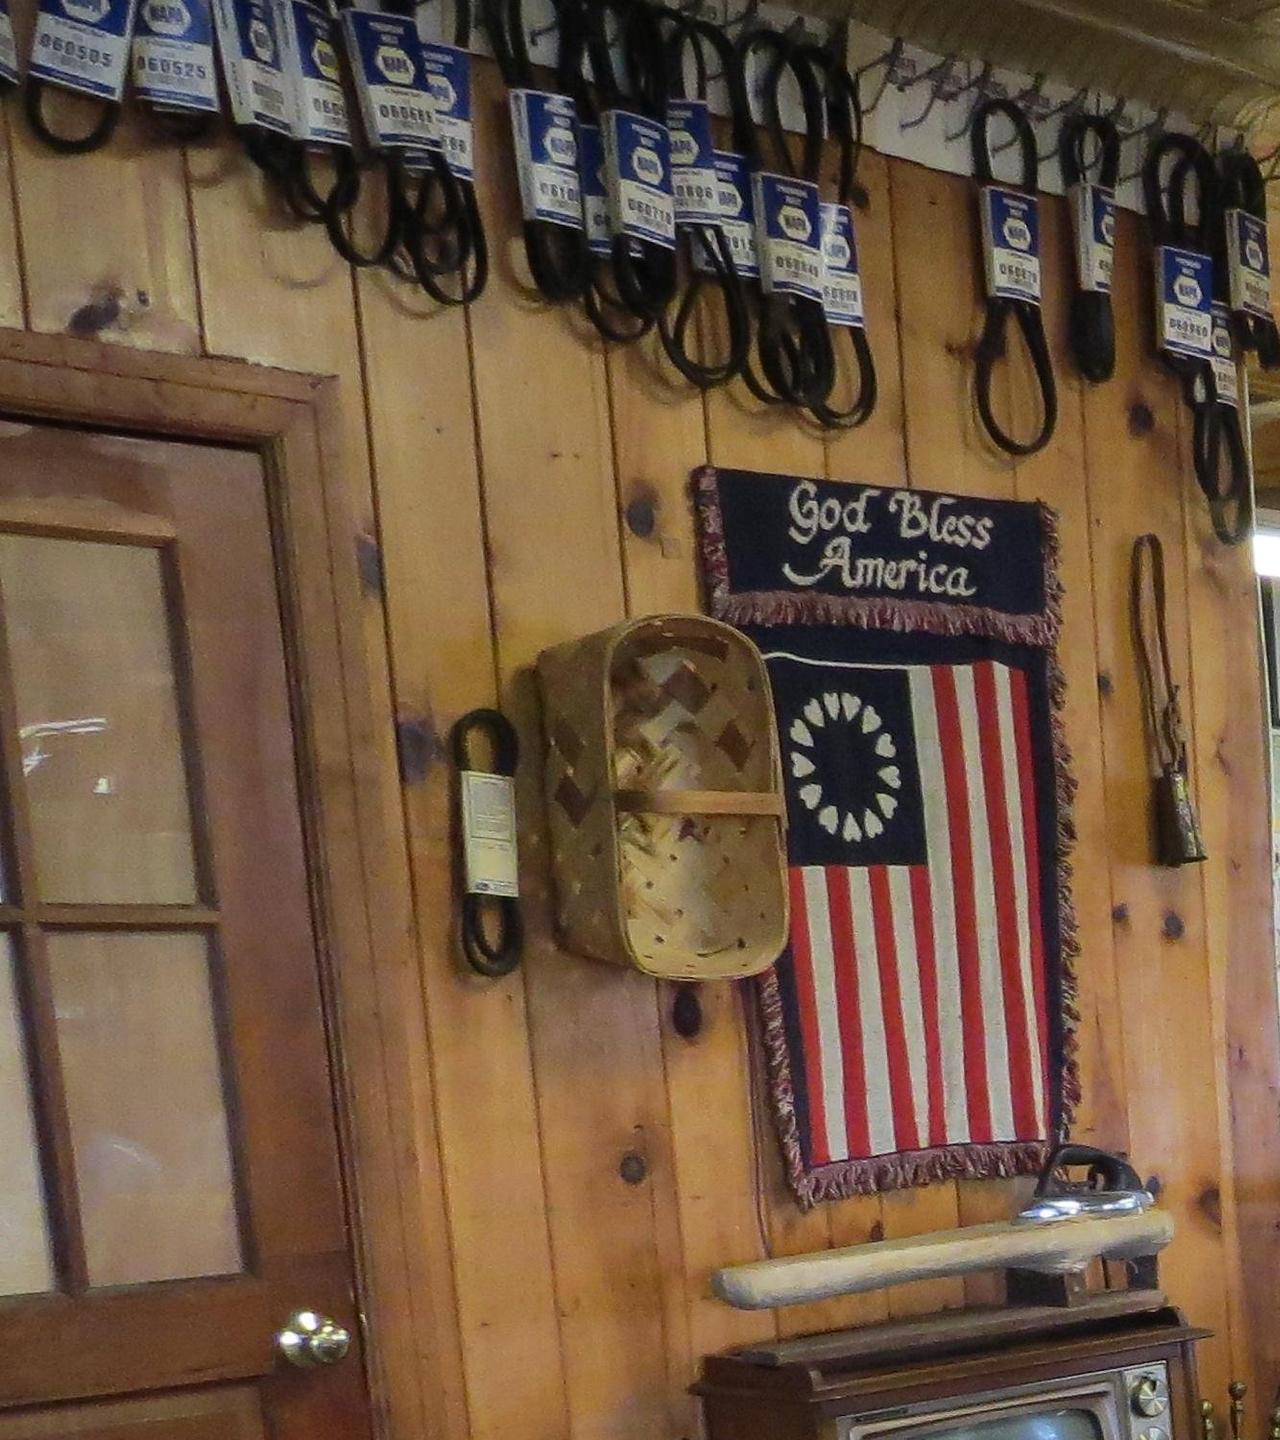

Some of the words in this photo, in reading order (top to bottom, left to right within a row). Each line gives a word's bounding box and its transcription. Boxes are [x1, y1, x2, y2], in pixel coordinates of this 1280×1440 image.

[788, 478, 883, 546] God
[888, 489, 995, 551] Bless
[780, 534, 979, 598] America
